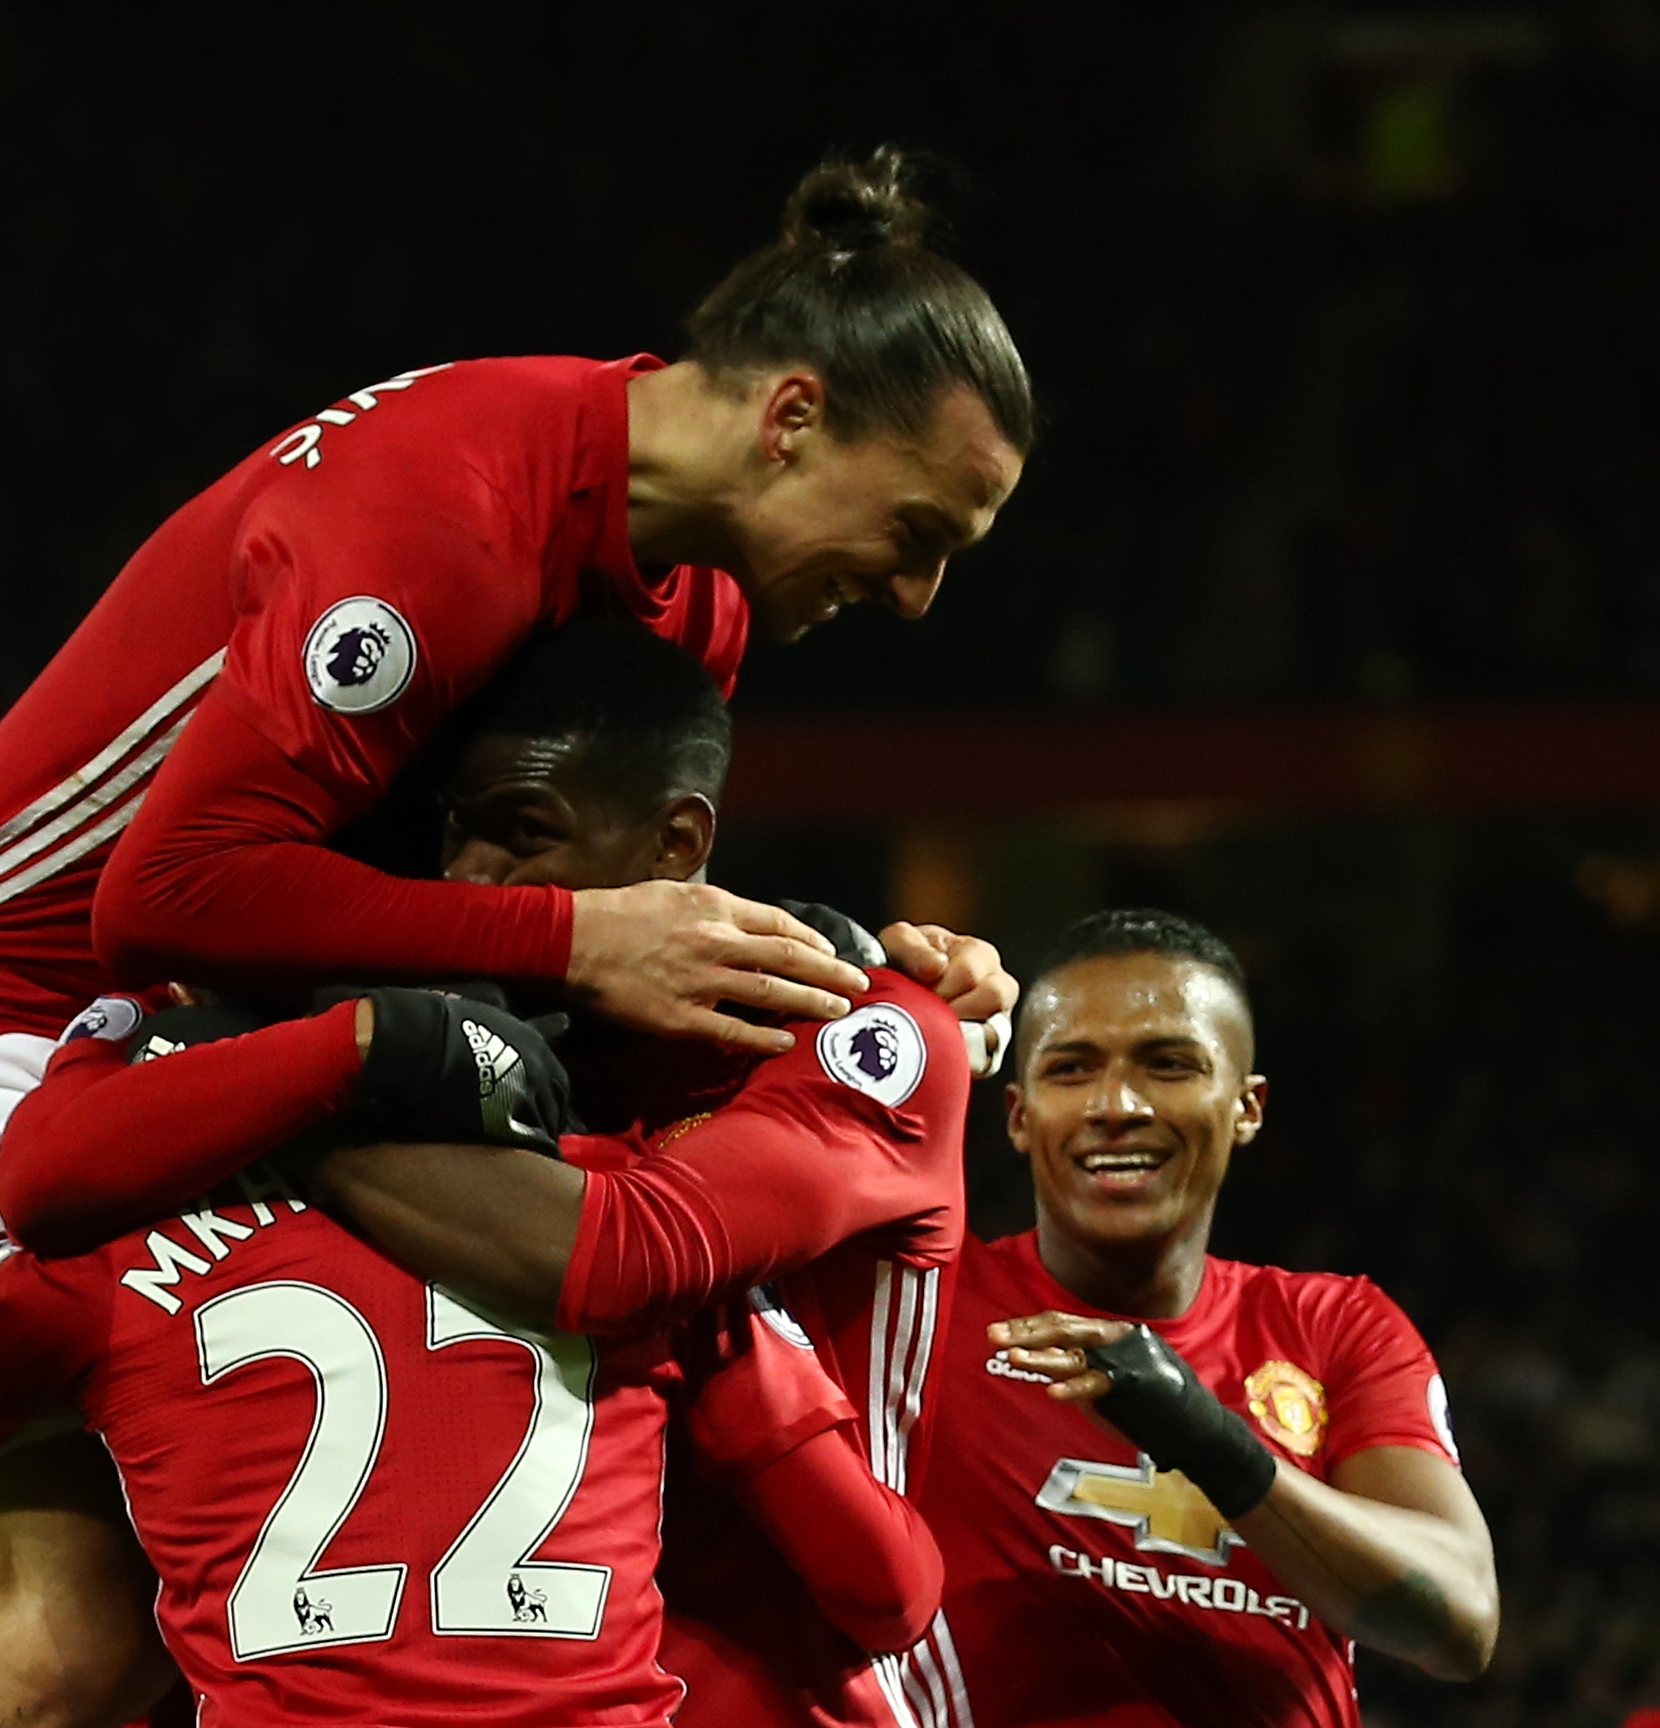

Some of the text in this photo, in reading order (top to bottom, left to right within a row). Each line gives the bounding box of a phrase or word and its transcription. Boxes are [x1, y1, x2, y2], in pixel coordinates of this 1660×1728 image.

[461, 1019, 494, 1097] adidas
[193, 1281, 613, 1662] 22
[1048, 1543, 1310, 1631] CHEVROLET
